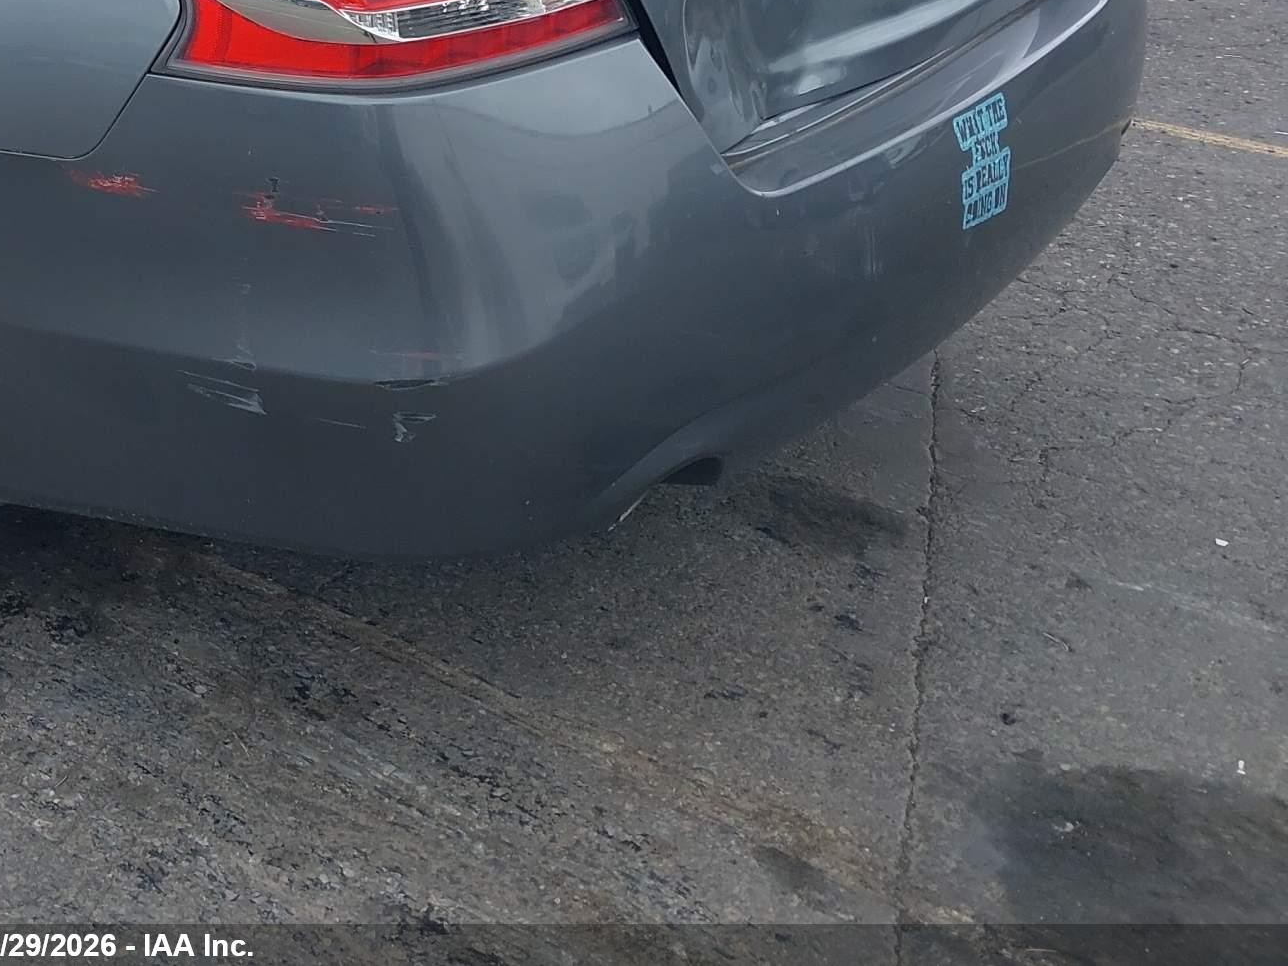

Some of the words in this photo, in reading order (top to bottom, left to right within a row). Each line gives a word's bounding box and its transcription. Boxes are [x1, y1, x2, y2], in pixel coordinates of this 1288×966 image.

[956, 109, 986, 143] WHAT
[987, 99, 1005, 129] THE
[965, 177, 974, 200] IS
[976, 154, 1009, 193] REALLY
[966, 192, 992, 225] GOING
[994, 183, 1007, 210] ON
